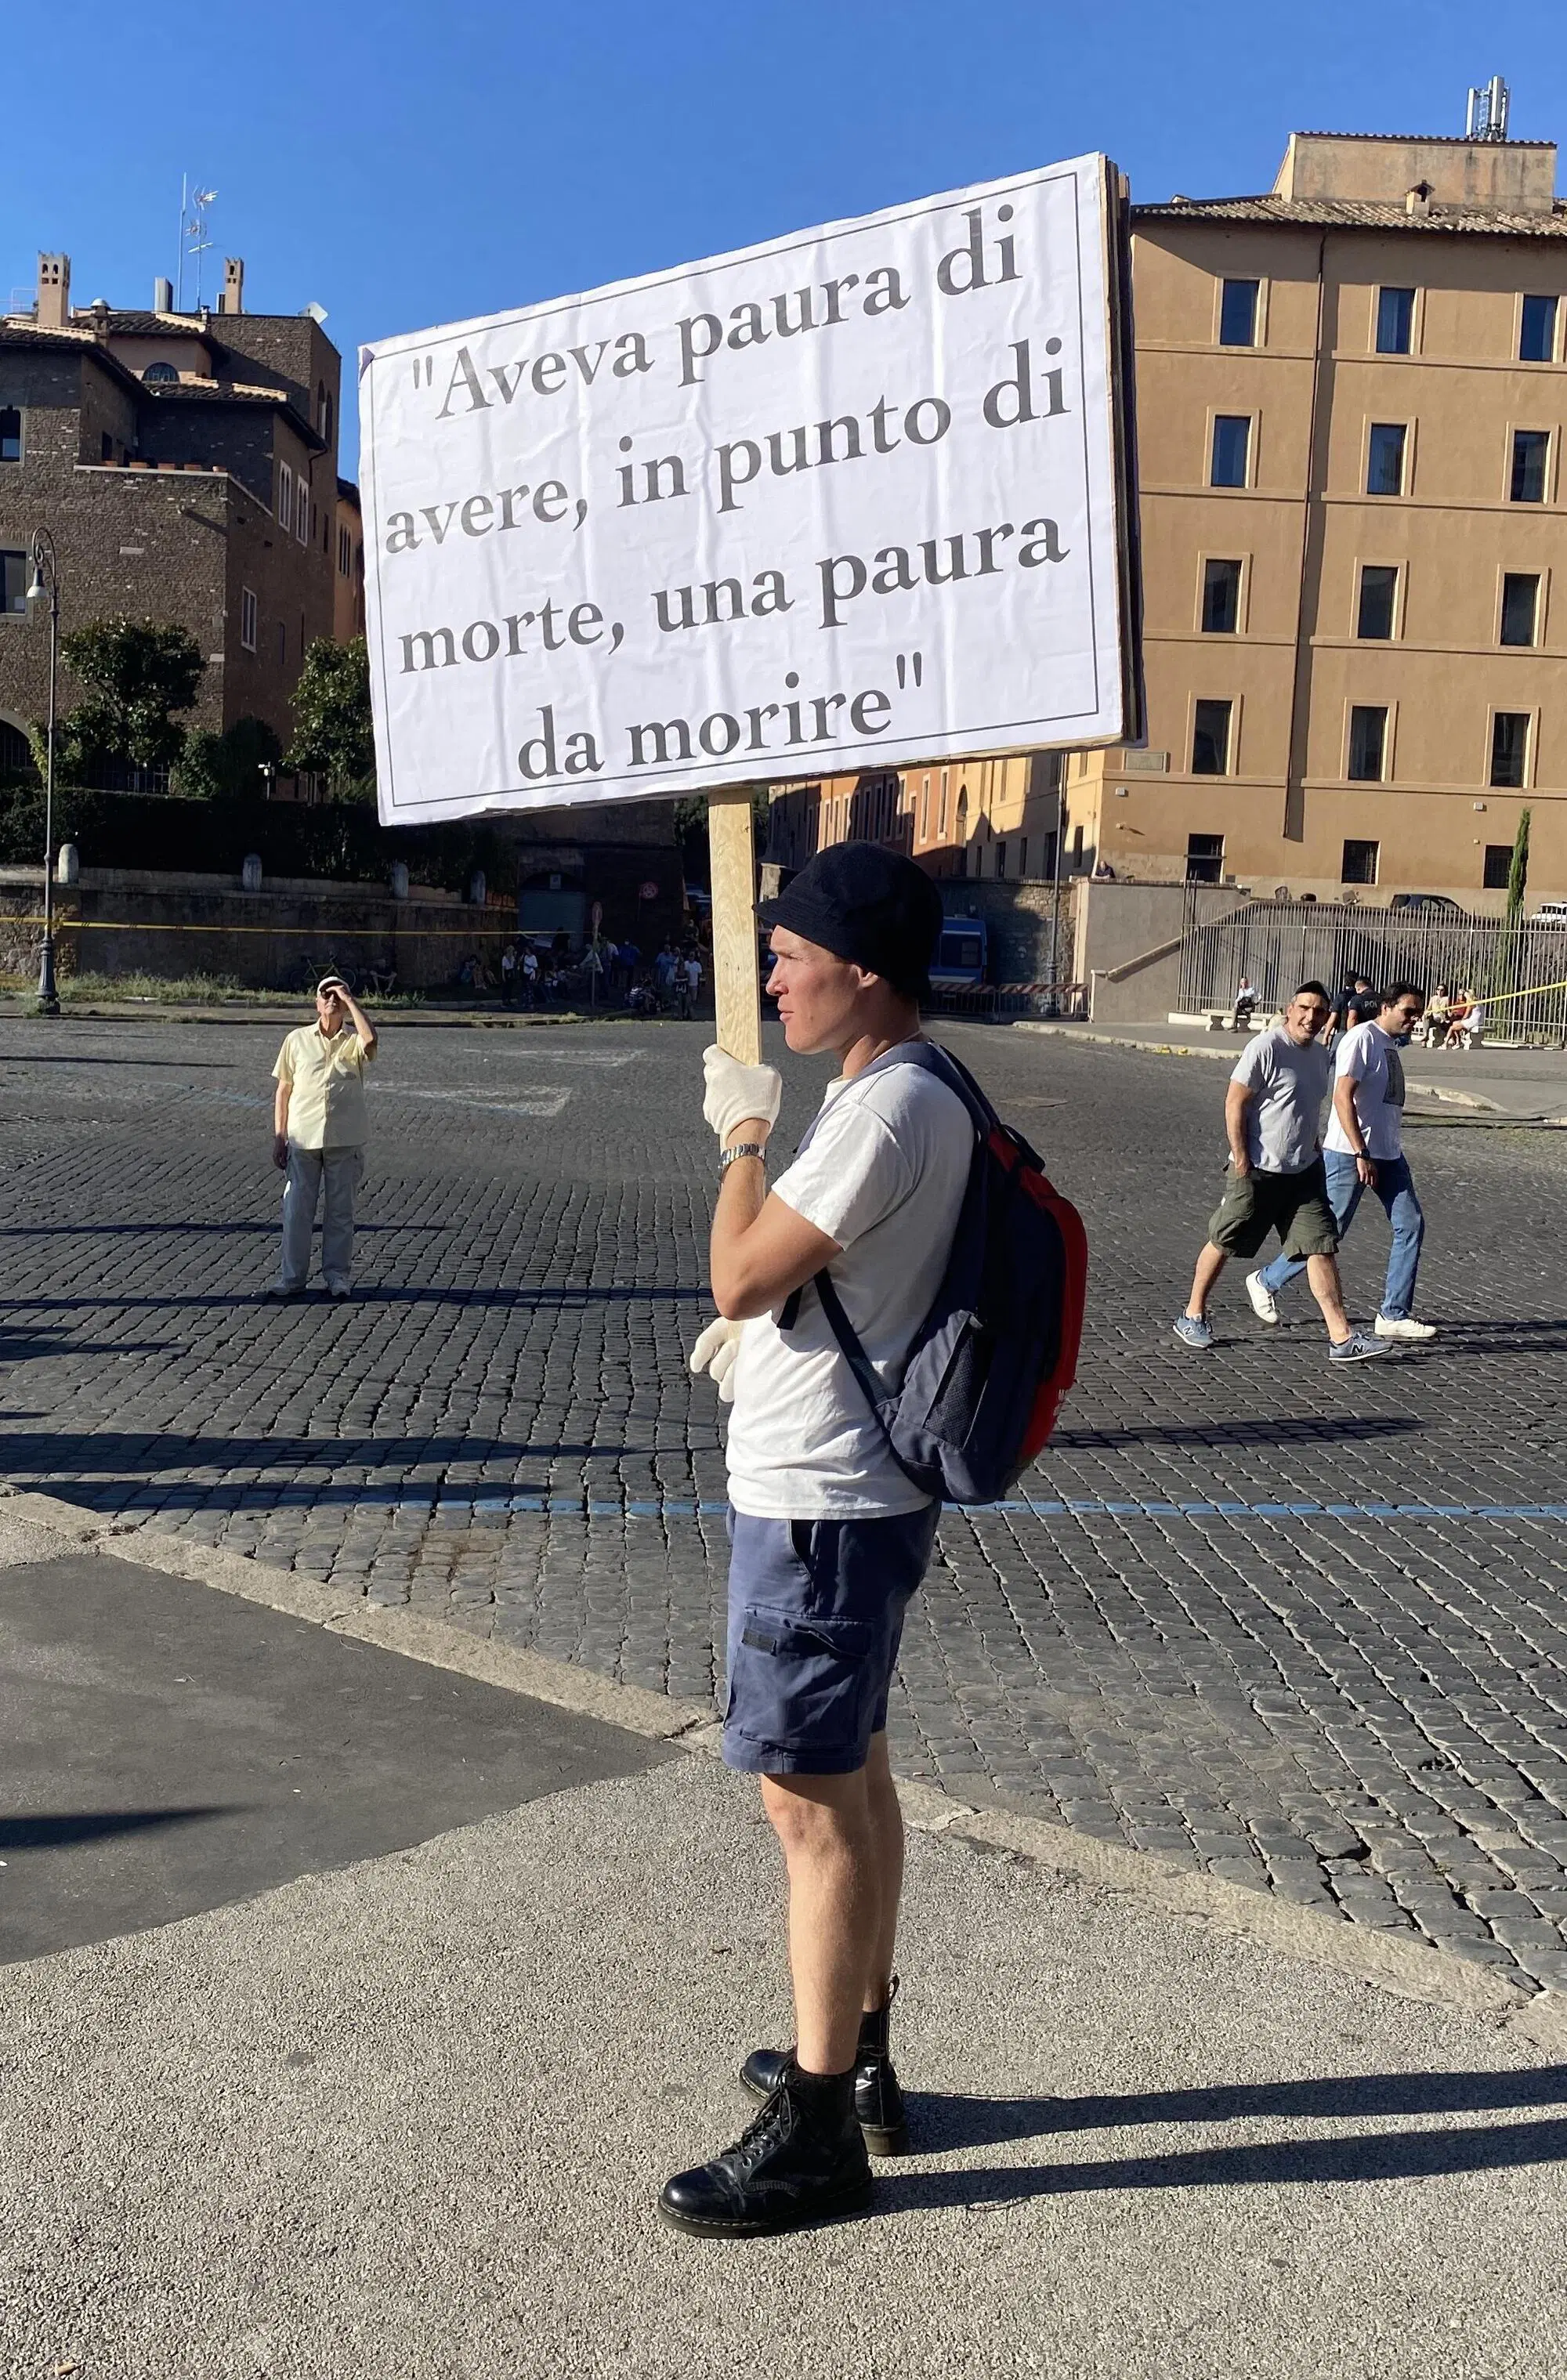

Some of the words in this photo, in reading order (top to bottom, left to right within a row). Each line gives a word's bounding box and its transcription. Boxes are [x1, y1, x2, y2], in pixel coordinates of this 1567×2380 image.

[412, 332, 655, 419] "Aveva
[675, 267, 911, 388] paura
[937, 204, 1023, 296] di
[385, 480, 588, 554] avere,
[616, 436, 691, 508] in
[715, 394, 951, 514] punto
[983, 337, 1072, 429] di
[398, 596, 624, 675] morte,
[651, 570, 796, 632] una
[816, 518, 1071, 630] paura
[518, 704, 606, 779] da
[624, 652, 922, 767] morire"
